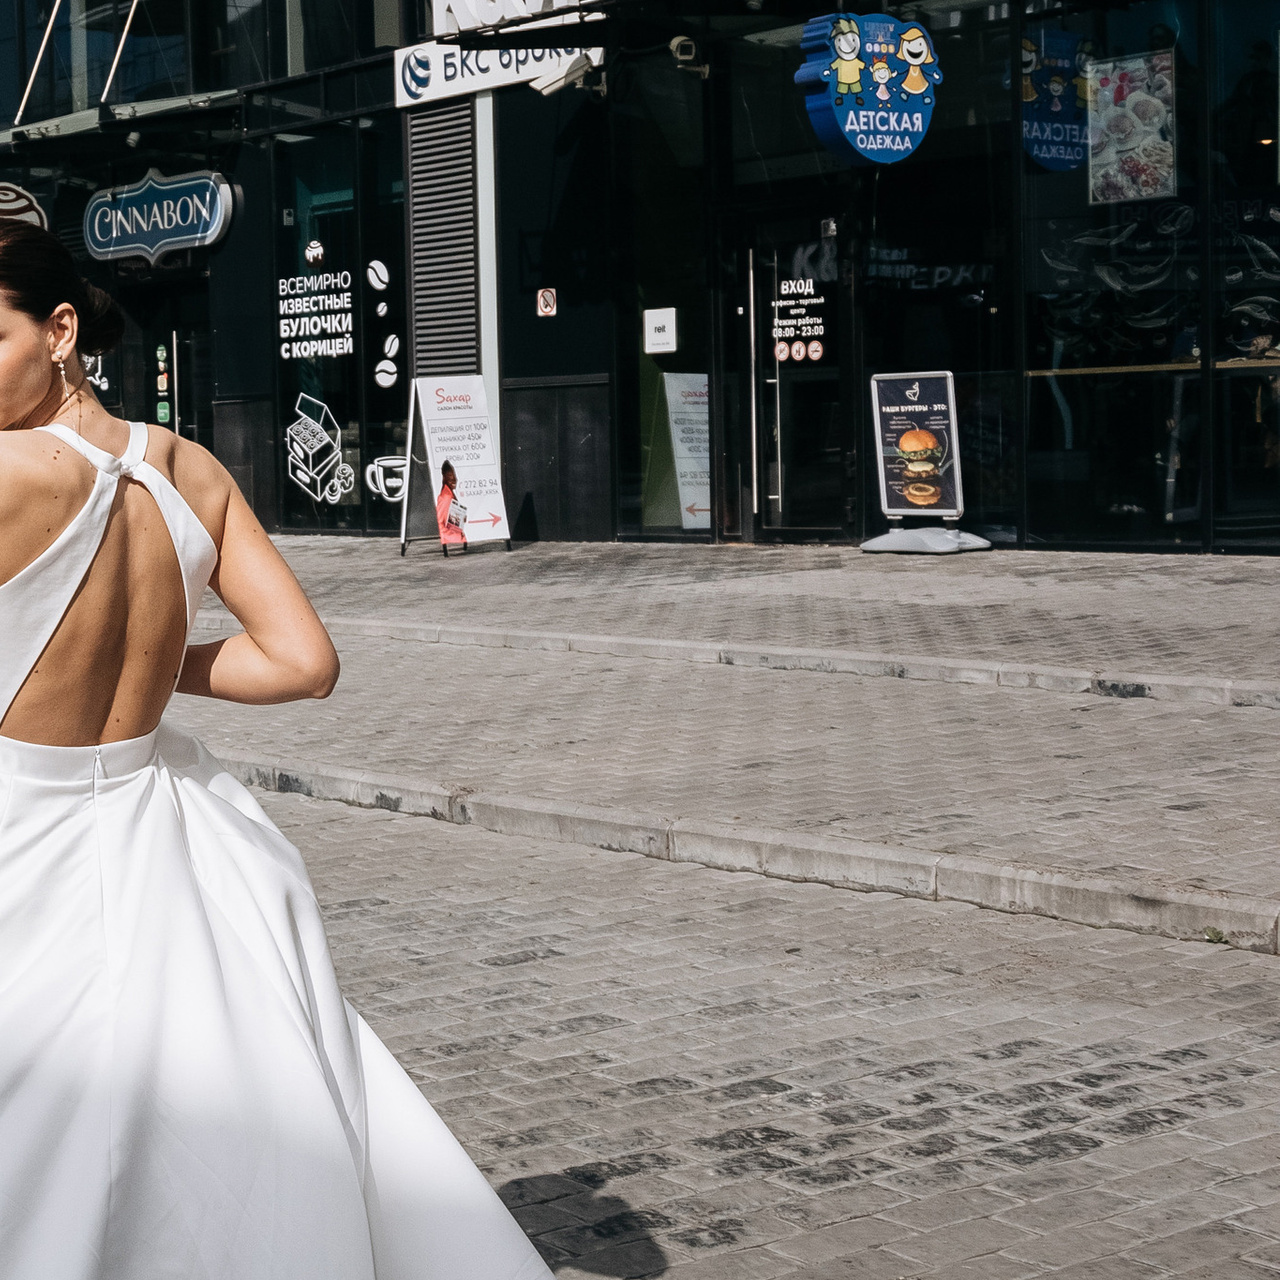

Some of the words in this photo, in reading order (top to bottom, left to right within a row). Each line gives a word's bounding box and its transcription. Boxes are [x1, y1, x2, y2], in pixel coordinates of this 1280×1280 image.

[443, 48, 490, 81] БКС
[844, 110, 923, 132] ДЕТСКАЯ
[857, 134, 912, 151] ОДЕЖДА
[95, 191, 210, 241] CINNABON
[279, 271, 351, 296] ВСЕМИРНО
[781, 279, 814, 295] ВХОД
[279, 292, 352, 315] ИЗВЕСТНЫЕ
[280, 313, 353, 338] БУЛОЧКИ
[772, 327, 795, 338] 08:00
[801, 325, 824, 336] 23:00
[797, 316, 822, 326] работы
[281, 343, 290, 359] С
[292, 333, 354, 358] КОРИЦЕЙ
[464, 480, 477, 488] 272
[478, 479, 487, 487] 82
[489, 478, 498, 486] 94
